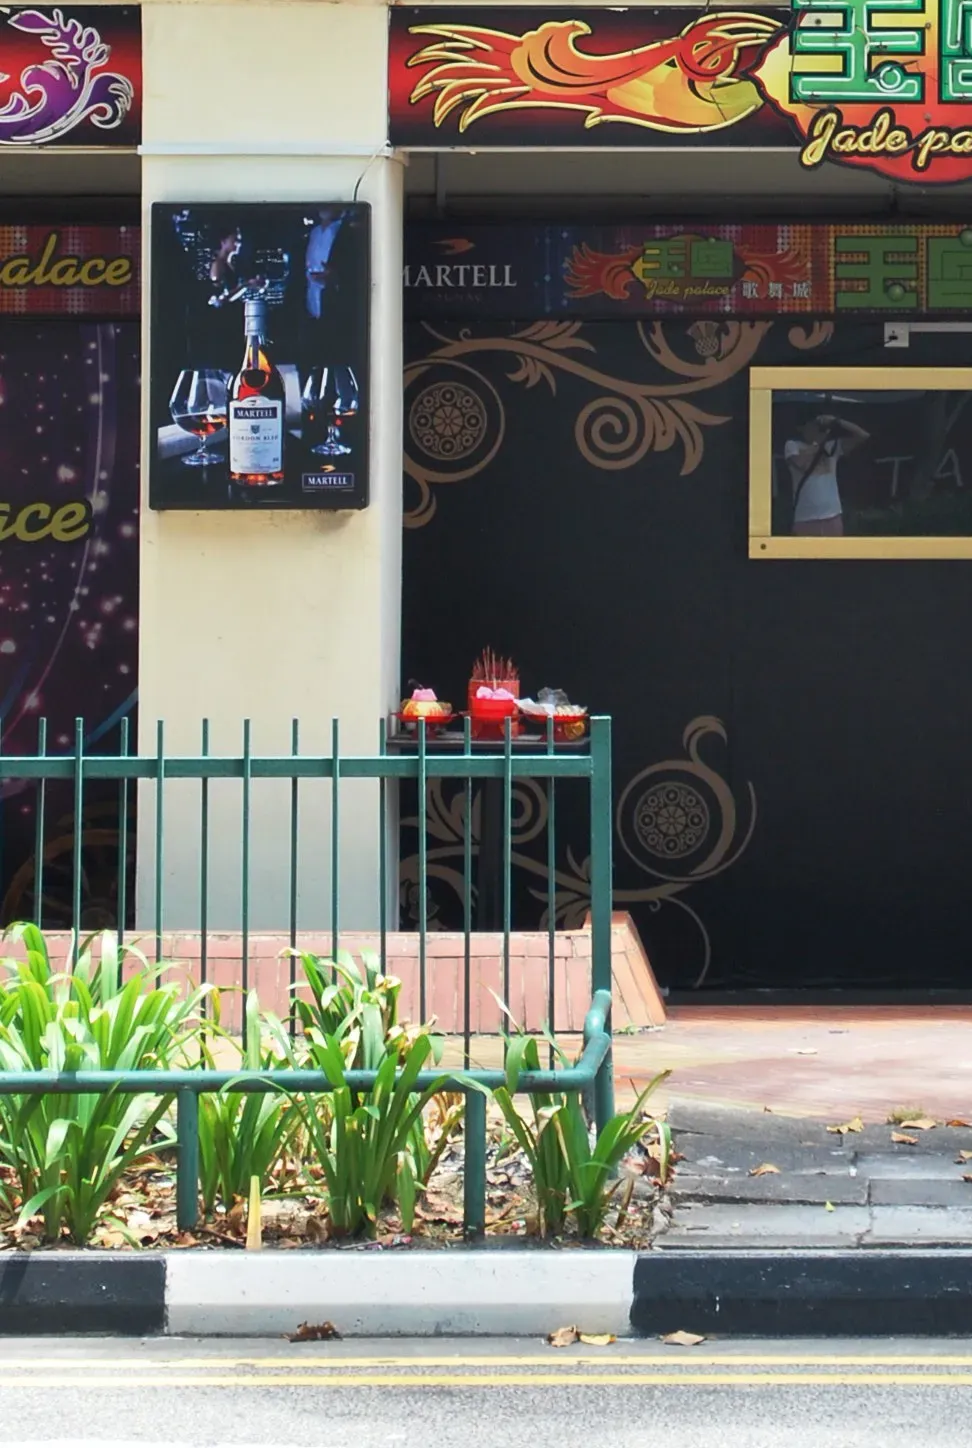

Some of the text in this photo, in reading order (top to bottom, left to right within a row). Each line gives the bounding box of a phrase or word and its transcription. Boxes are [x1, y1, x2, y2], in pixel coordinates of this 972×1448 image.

[800, 111, 908, 166] Jade
[646, 279, 730, 300] Jade palace
[236, 408, 274, 418] MARTELL
[307, 475, 348, 486] MARTELL
